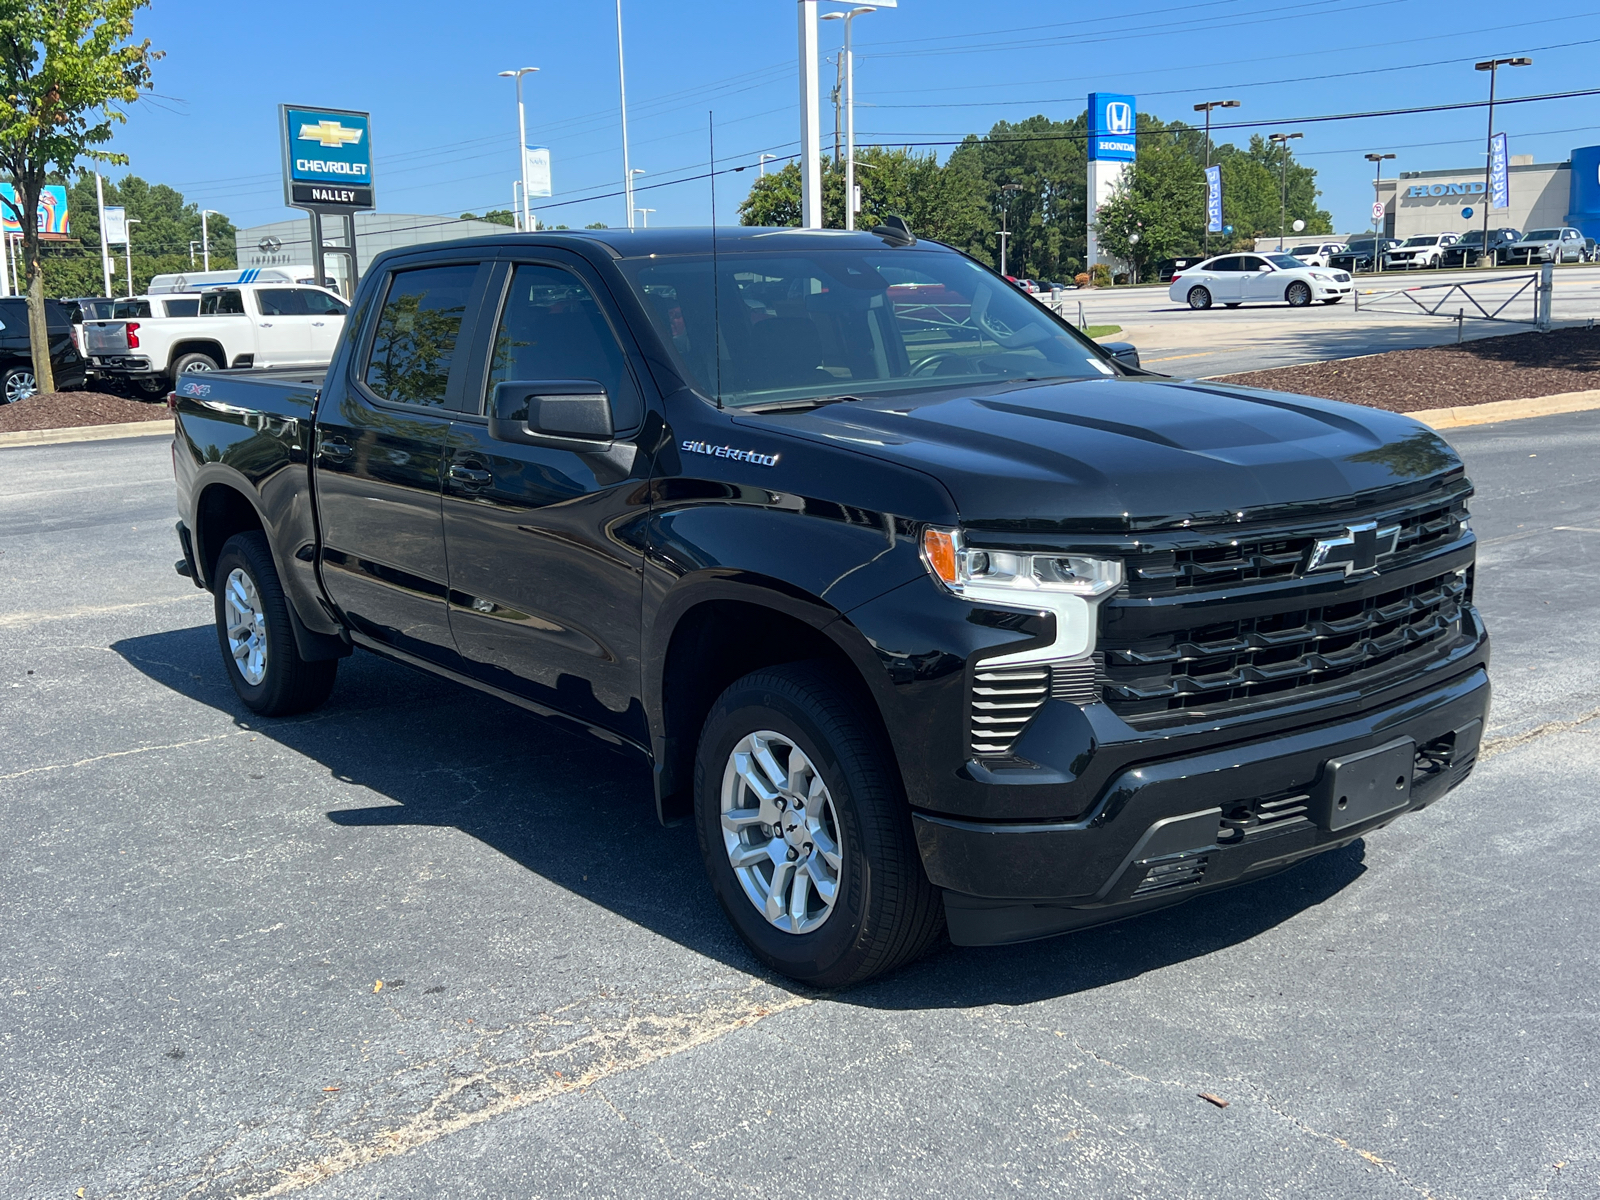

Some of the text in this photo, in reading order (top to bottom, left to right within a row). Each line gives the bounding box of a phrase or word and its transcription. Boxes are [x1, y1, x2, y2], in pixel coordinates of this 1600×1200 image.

[1099, 142, 1135, 152] HONDA
[296, 159, 367, 175] CHEVROLET
[312, 189, 355, 202] NALLEY
[1408, 182, 1493, 198] HOND
[681, 441, 778, 466] SILVERADO
[844, 811, 862, 915] MICHELIN
